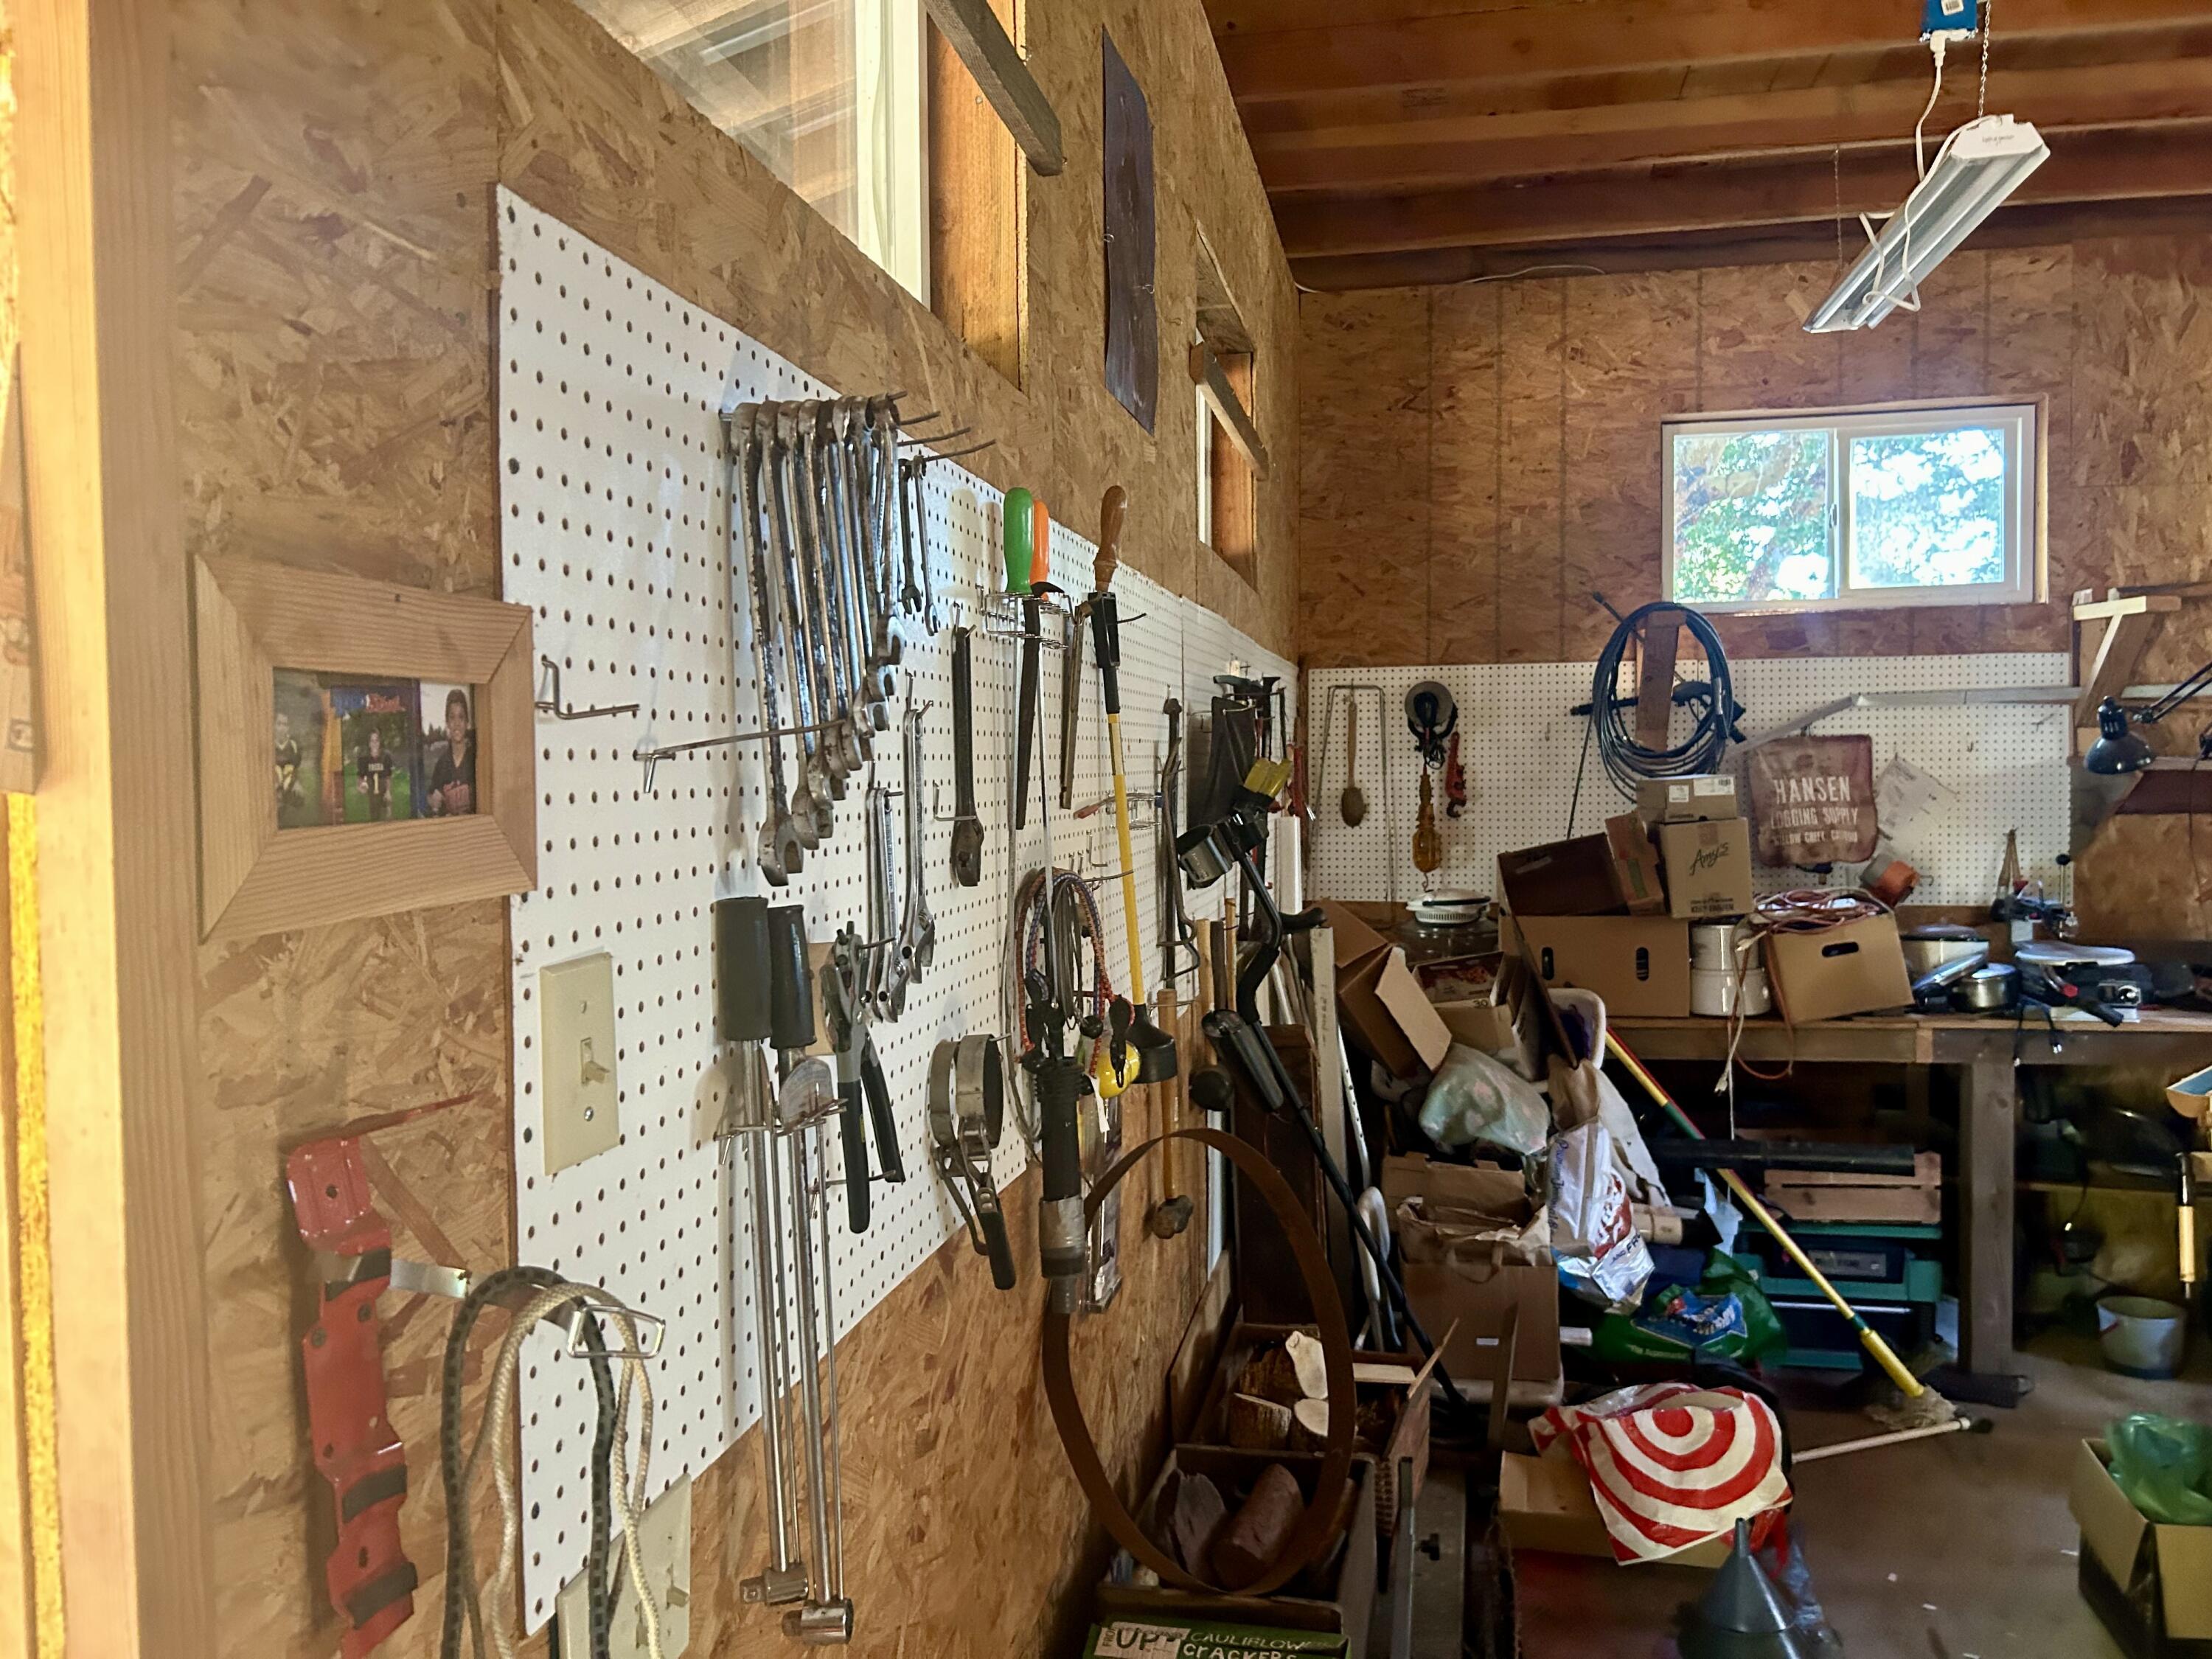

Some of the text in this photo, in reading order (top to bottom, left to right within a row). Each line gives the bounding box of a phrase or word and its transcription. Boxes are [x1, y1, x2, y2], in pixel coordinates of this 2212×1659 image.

[1773, 776, 1851, 804] HANSEN
[1770, 806, 1859, 830] LOGGING SUPPLY
[1191, 1632, 1315, 1650] CAULIFLOW
